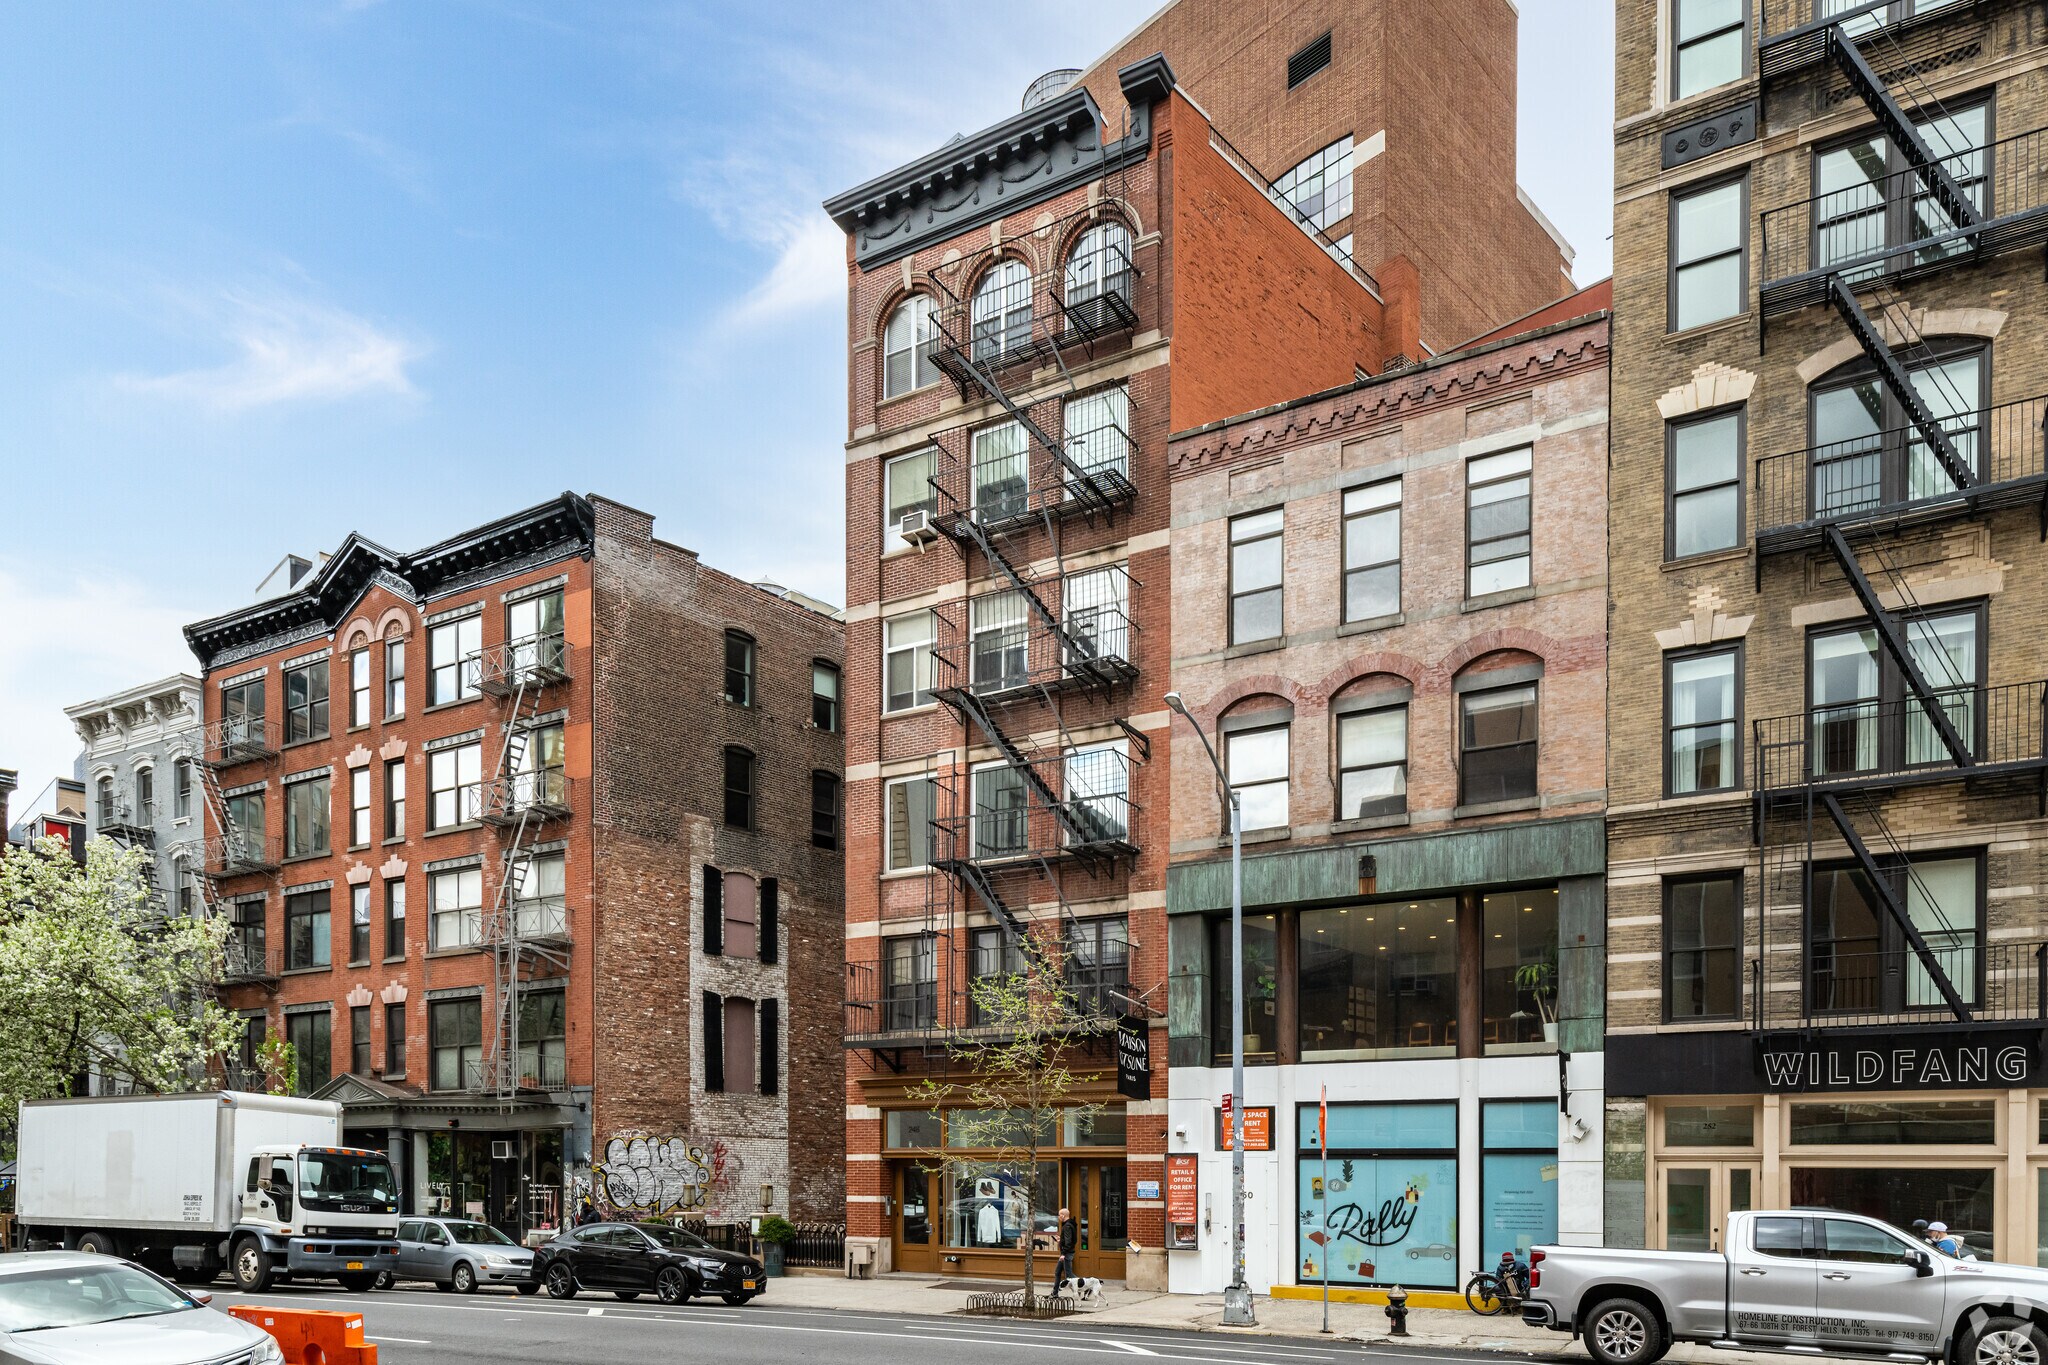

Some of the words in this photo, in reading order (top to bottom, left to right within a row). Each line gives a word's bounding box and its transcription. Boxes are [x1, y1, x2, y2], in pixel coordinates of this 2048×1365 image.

[1118, 1050, 1148, 1072] ITSUNÉ
[1763, 1046, 2027, 1086] WILDFANG
[1125, 1073, 1137, 1082] PARIS
[1702, 1122, 1717, 1130] 252
[420, 1181, 445, 1190] LIVELY
[340, 1204, 370, 1212] ISUZU
[1326, 1196, 1418, 1247] Rally
[1738, 1312, 1779, 1323] HOMELINE
[1781, 1314, 1848, 1329] CONSTRUCTION,
[1851, 1319, 1868, 1329] INC.
[1761, 1322, 1779, 1330] 108TH
[1792, 1324, 1818, 1334] FOREST
[1853, 1328, 1870, 1337] 11375
[1875, 1330, 1886, 1338] Tel:
[1887, 1331, 1935, 1342] 917-749-8150
